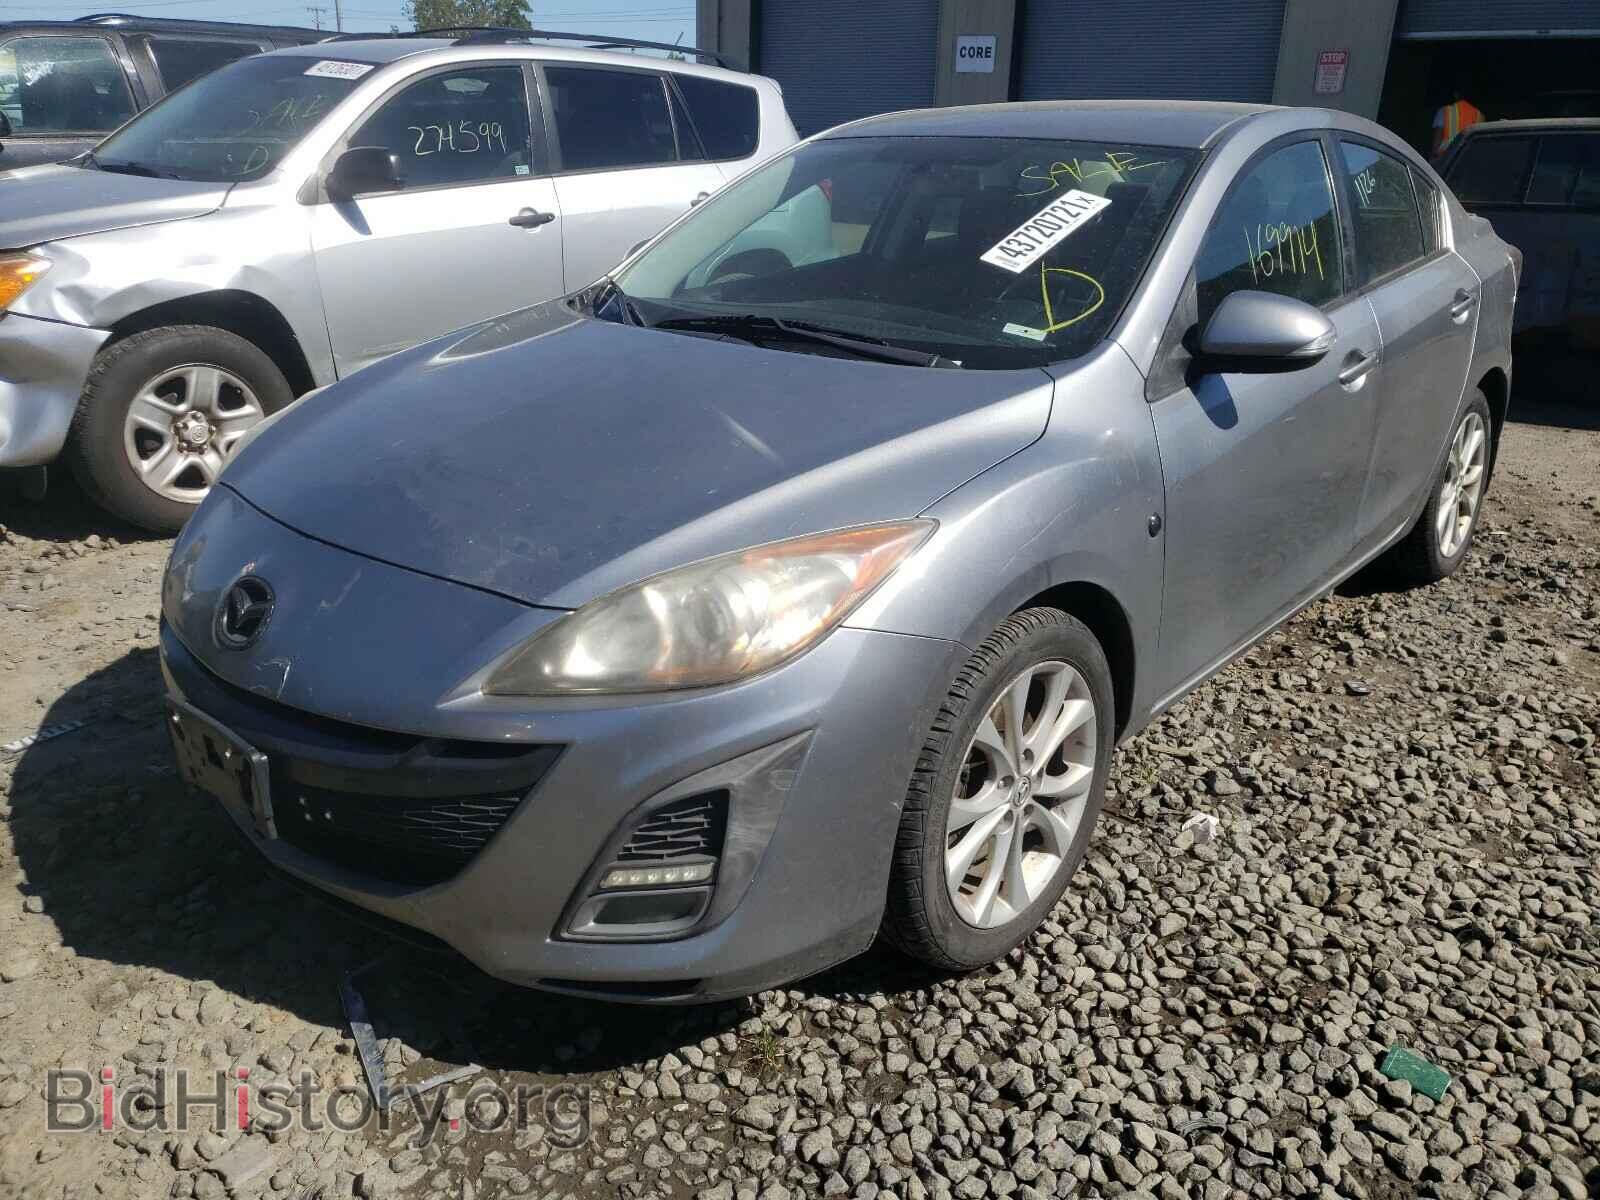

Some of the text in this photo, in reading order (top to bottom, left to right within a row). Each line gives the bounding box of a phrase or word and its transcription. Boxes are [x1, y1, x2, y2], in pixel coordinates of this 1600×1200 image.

[959, 46, 993, 59] CORE
[1320, 52, 1345, 63] STOP
[1016, 152, 1169, 197] SALE
[998, 199, 1090, 259] 43720721
[1040, 261, 1105, 334] D
